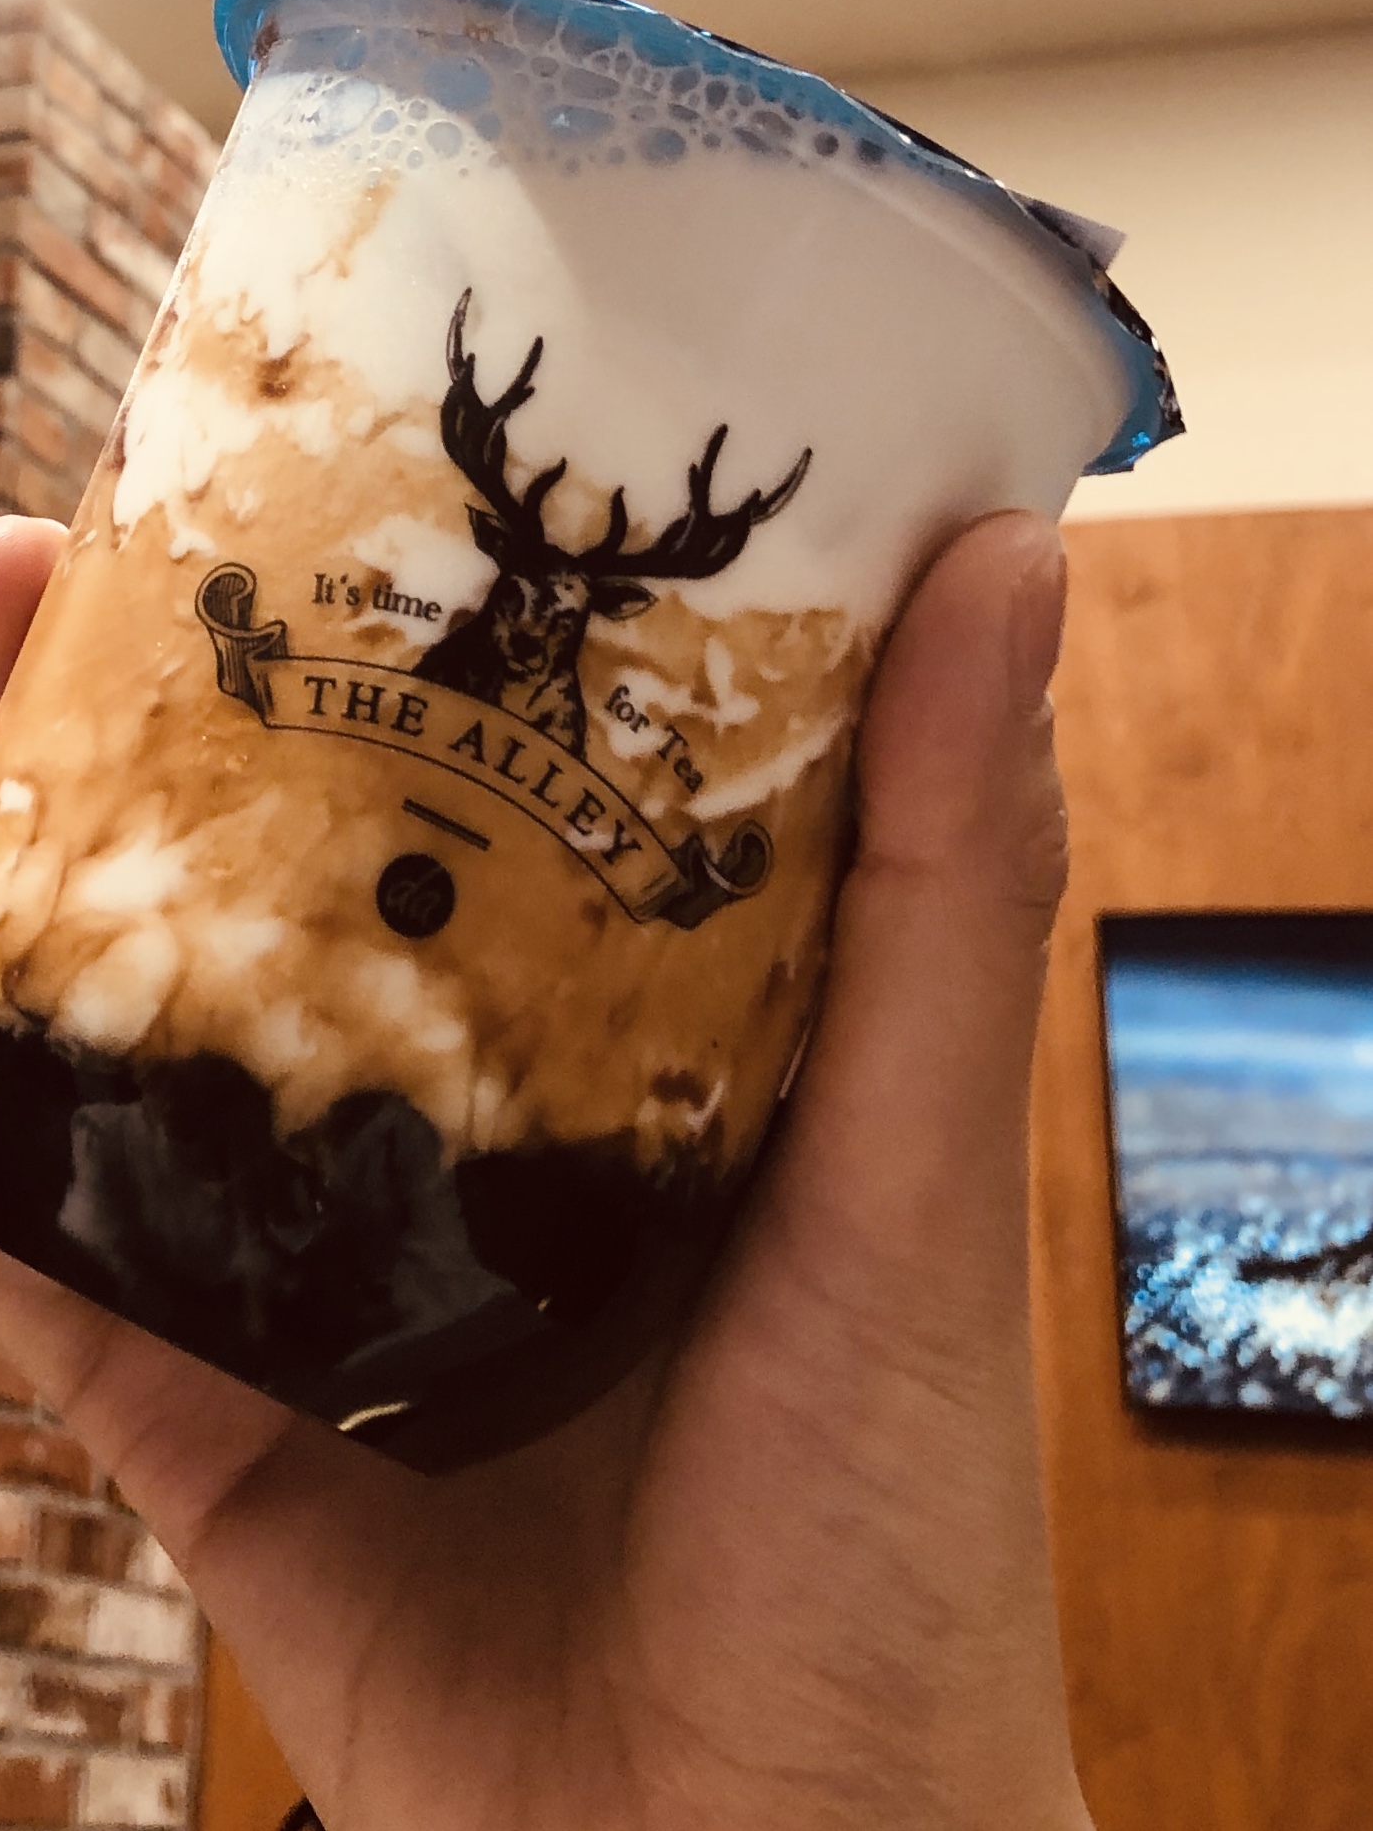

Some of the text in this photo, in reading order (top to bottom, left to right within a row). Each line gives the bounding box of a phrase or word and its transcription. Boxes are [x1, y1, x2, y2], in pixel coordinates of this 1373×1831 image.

[312, 573, 443, 622] It's time
[303, 675, 643, 868] THE ALLEY
[605, 684, 703, 794] for Tea
